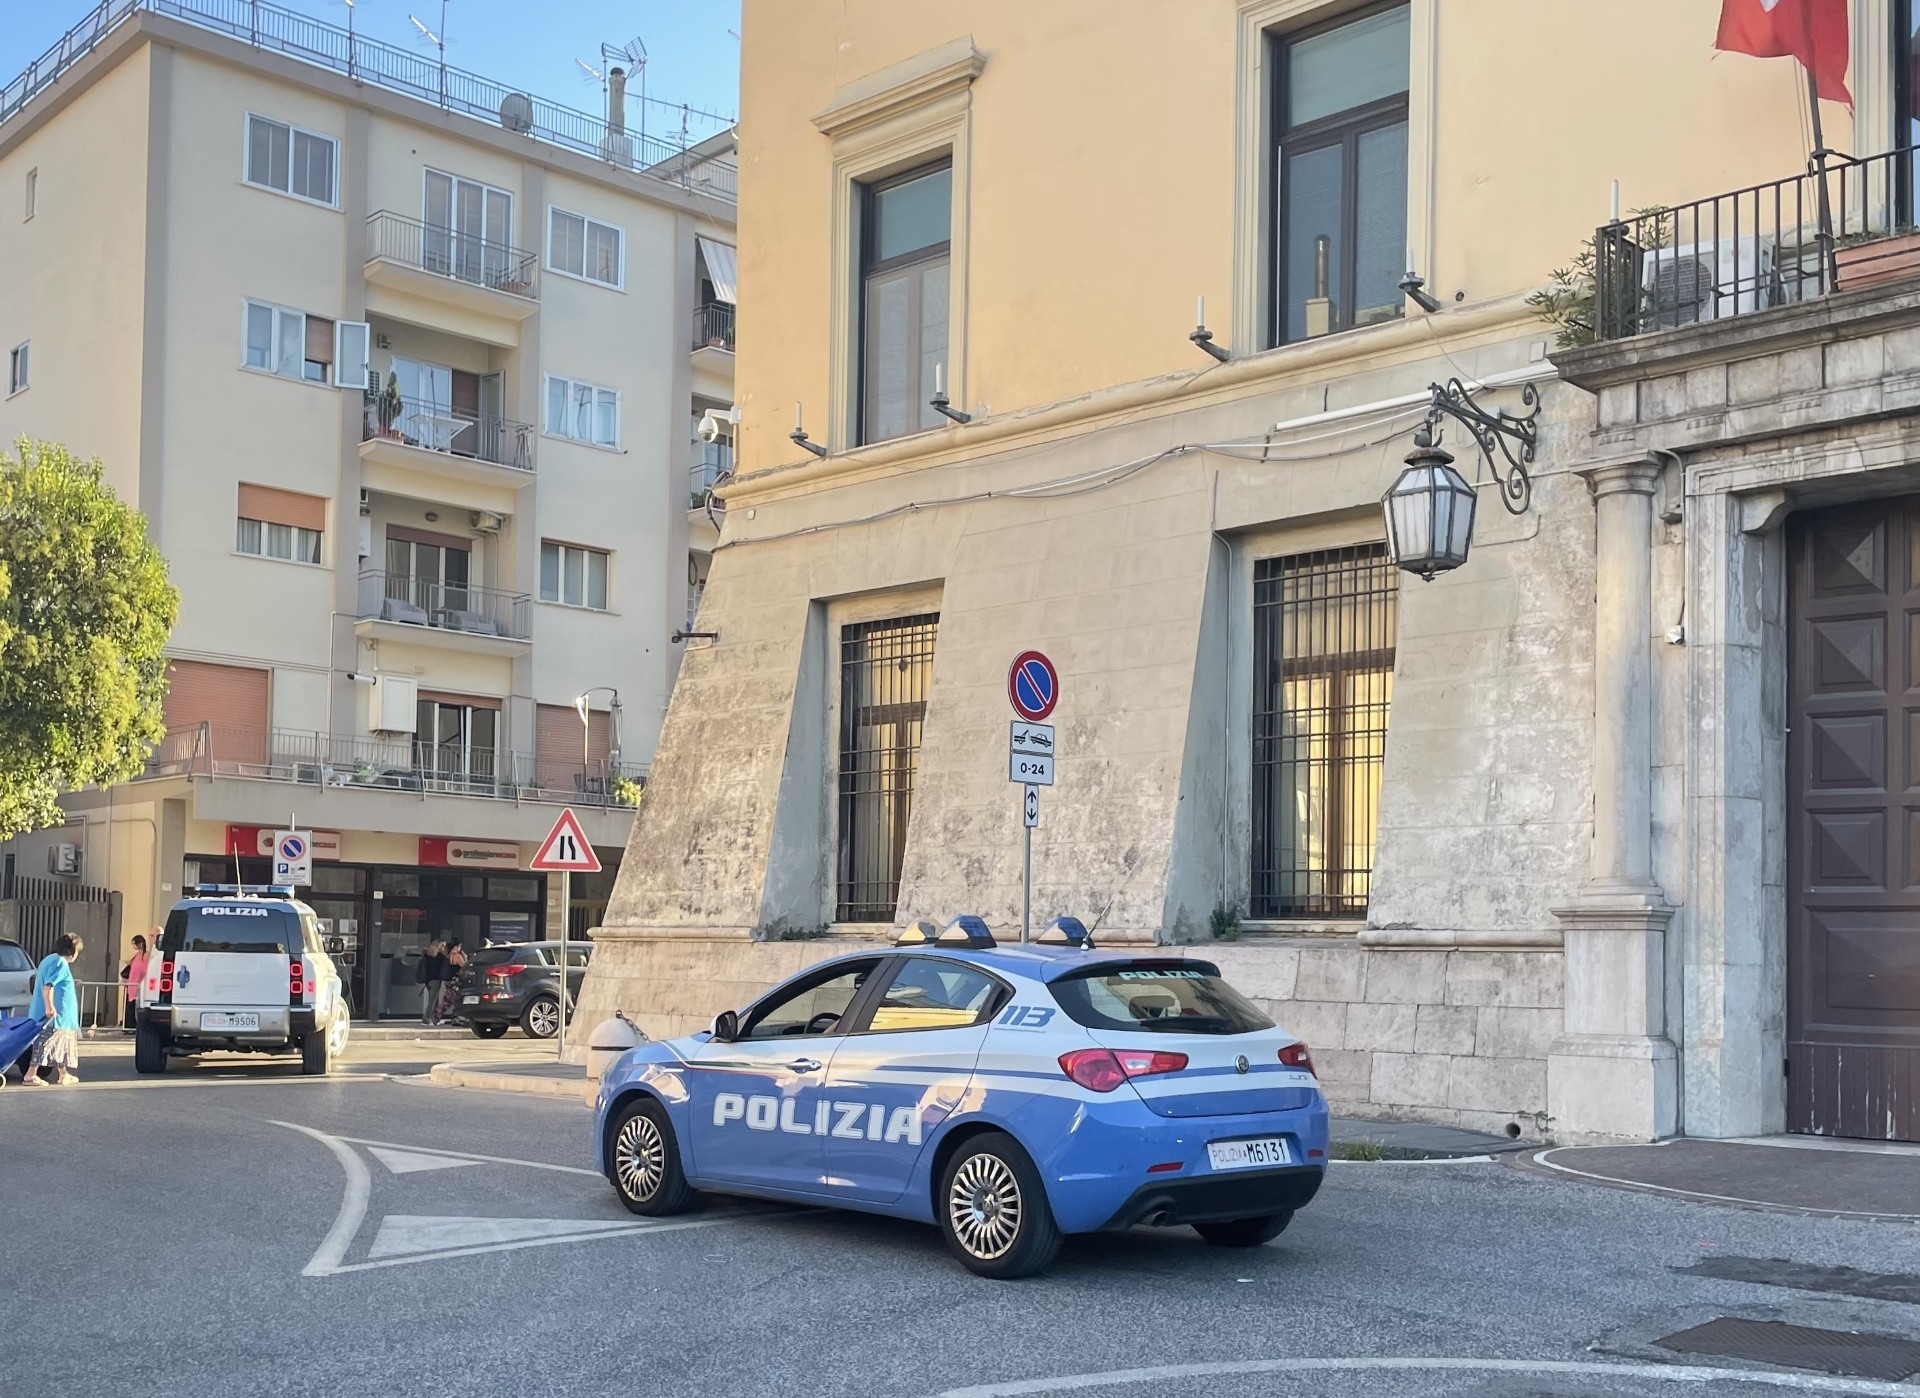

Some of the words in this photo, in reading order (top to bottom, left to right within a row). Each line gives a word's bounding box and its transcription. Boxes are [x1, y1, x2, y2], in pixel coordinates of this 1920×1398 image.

[1020, 762, 1044, 775] 0-24
[463, 849, 517, 859] professionecasa
[201, 906, 268, 917] POLIZIA
[1118, 971, 1205, 982] POLIZIA
[228, 1015, 257, 1026] M9506
[998, 1005, 1056, 1028] 113
[713, 1092, 923, 1146] POLIZIA
[1212, 1147, 1243, 1162] POLIZIA
[1246, 1141, 1286, 1164] M6131
